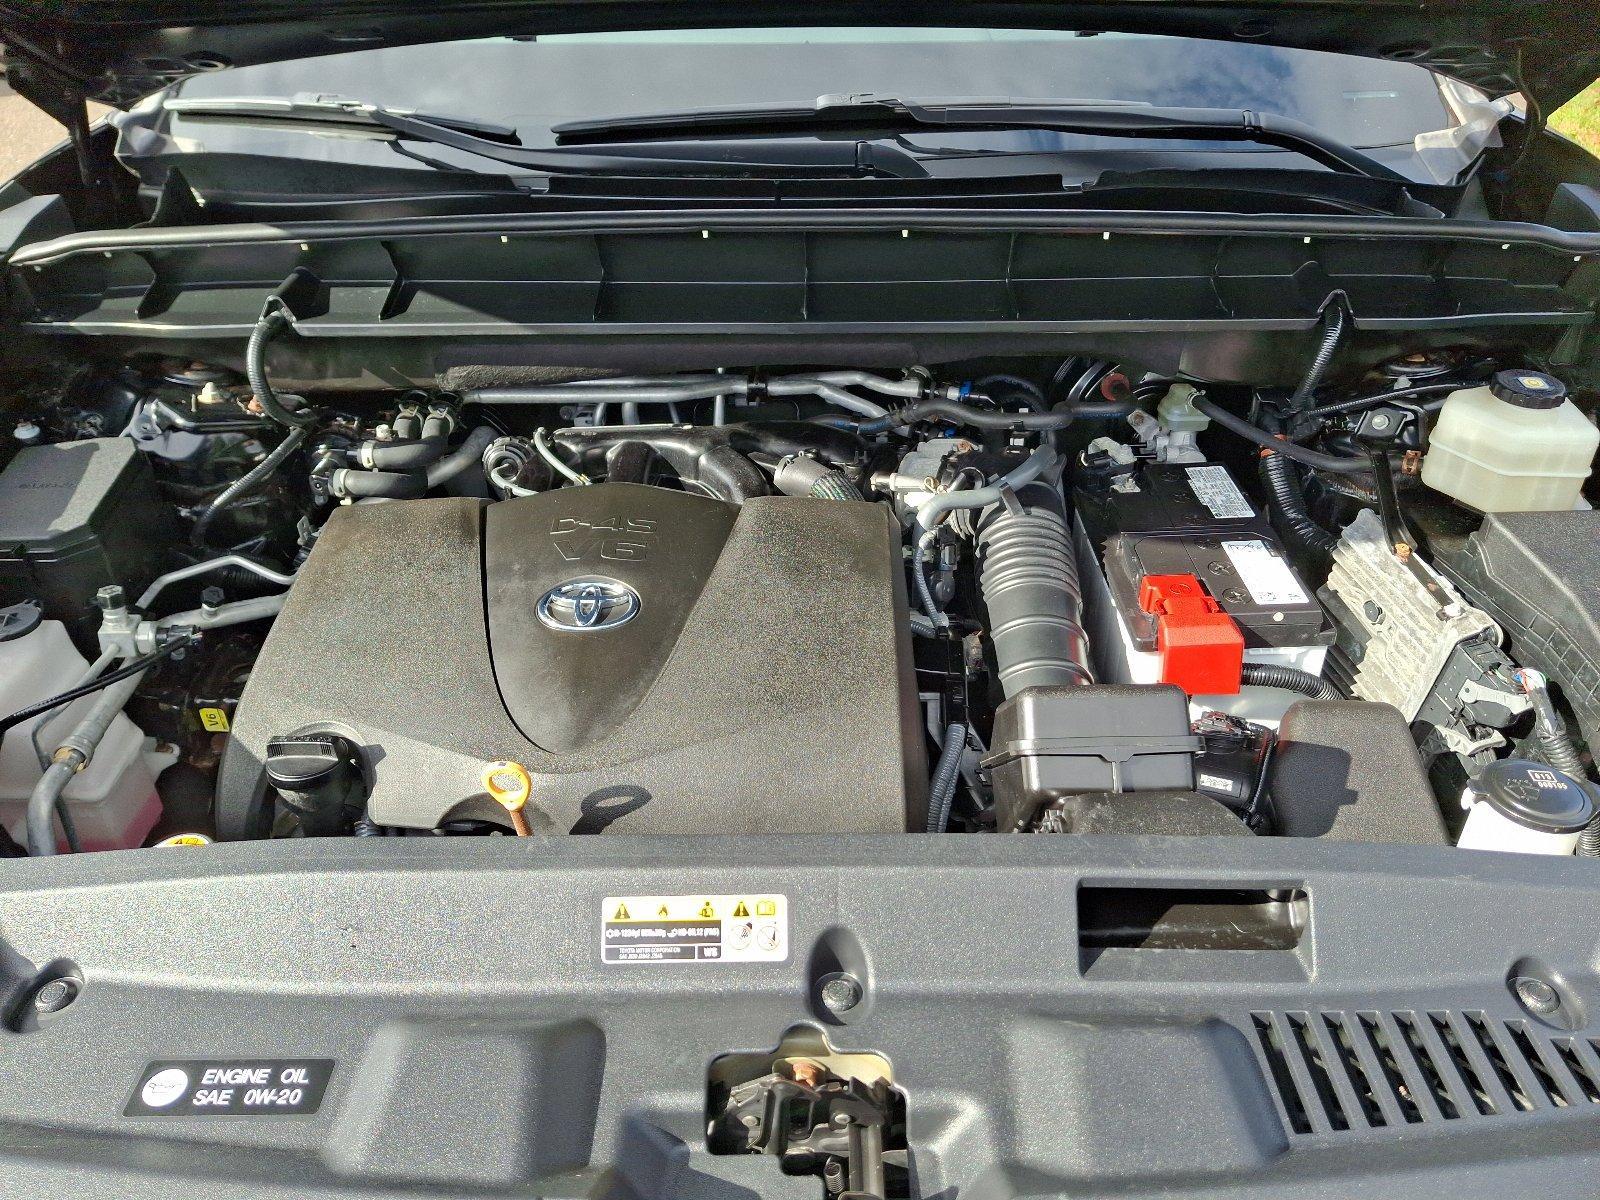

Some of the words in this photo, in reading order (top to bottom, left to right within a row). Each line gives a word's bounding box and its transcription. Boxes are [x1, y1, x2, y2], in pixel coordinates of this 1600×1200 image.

[552, 539, 648, 562] V6
[201, 1068, 272, 1085] ENGINE
[280, 1068, 309, 1085] OIL
[192, 1089, 234, 1106] SAE
[243, 1088, 303, 1106] 0W-20
